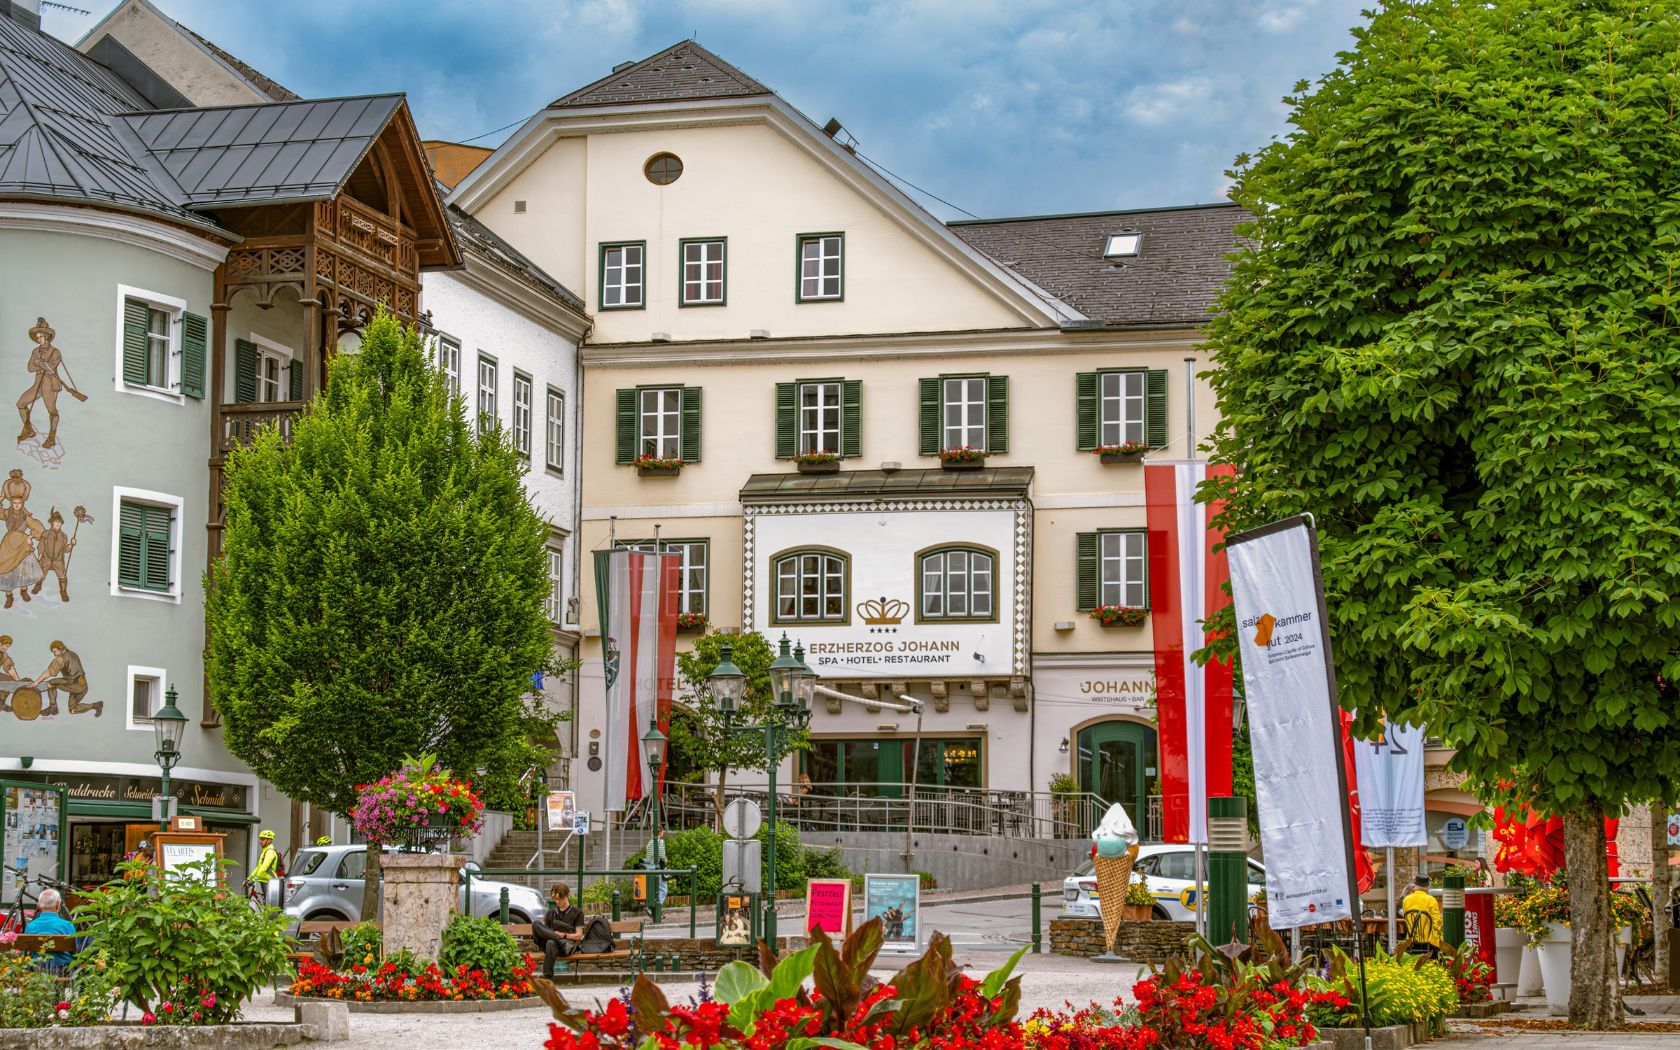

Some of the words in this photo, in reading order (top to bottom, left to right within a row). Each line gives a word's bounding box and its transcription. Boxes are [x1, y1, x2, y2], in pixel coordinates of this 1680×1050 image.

[1242, 615, 1261, 628] salz
[1275, 612, 1312, 628] kammer
[809, 641, 894, 654] ERZHERZOG
[898, 640, 960, 652] JOHANN
[1266, 636, 1282, 650] gut
[1285, 633, 1303, 644] 2024
[818, 656, 838, 665] SPA
[846, 656, 878, 664] HOTEL
[884, 654, 951, 664] RESTAURANT
[53, 782, 116, 798] nddrucke
[191, 784, 226, 807] Schmidt
